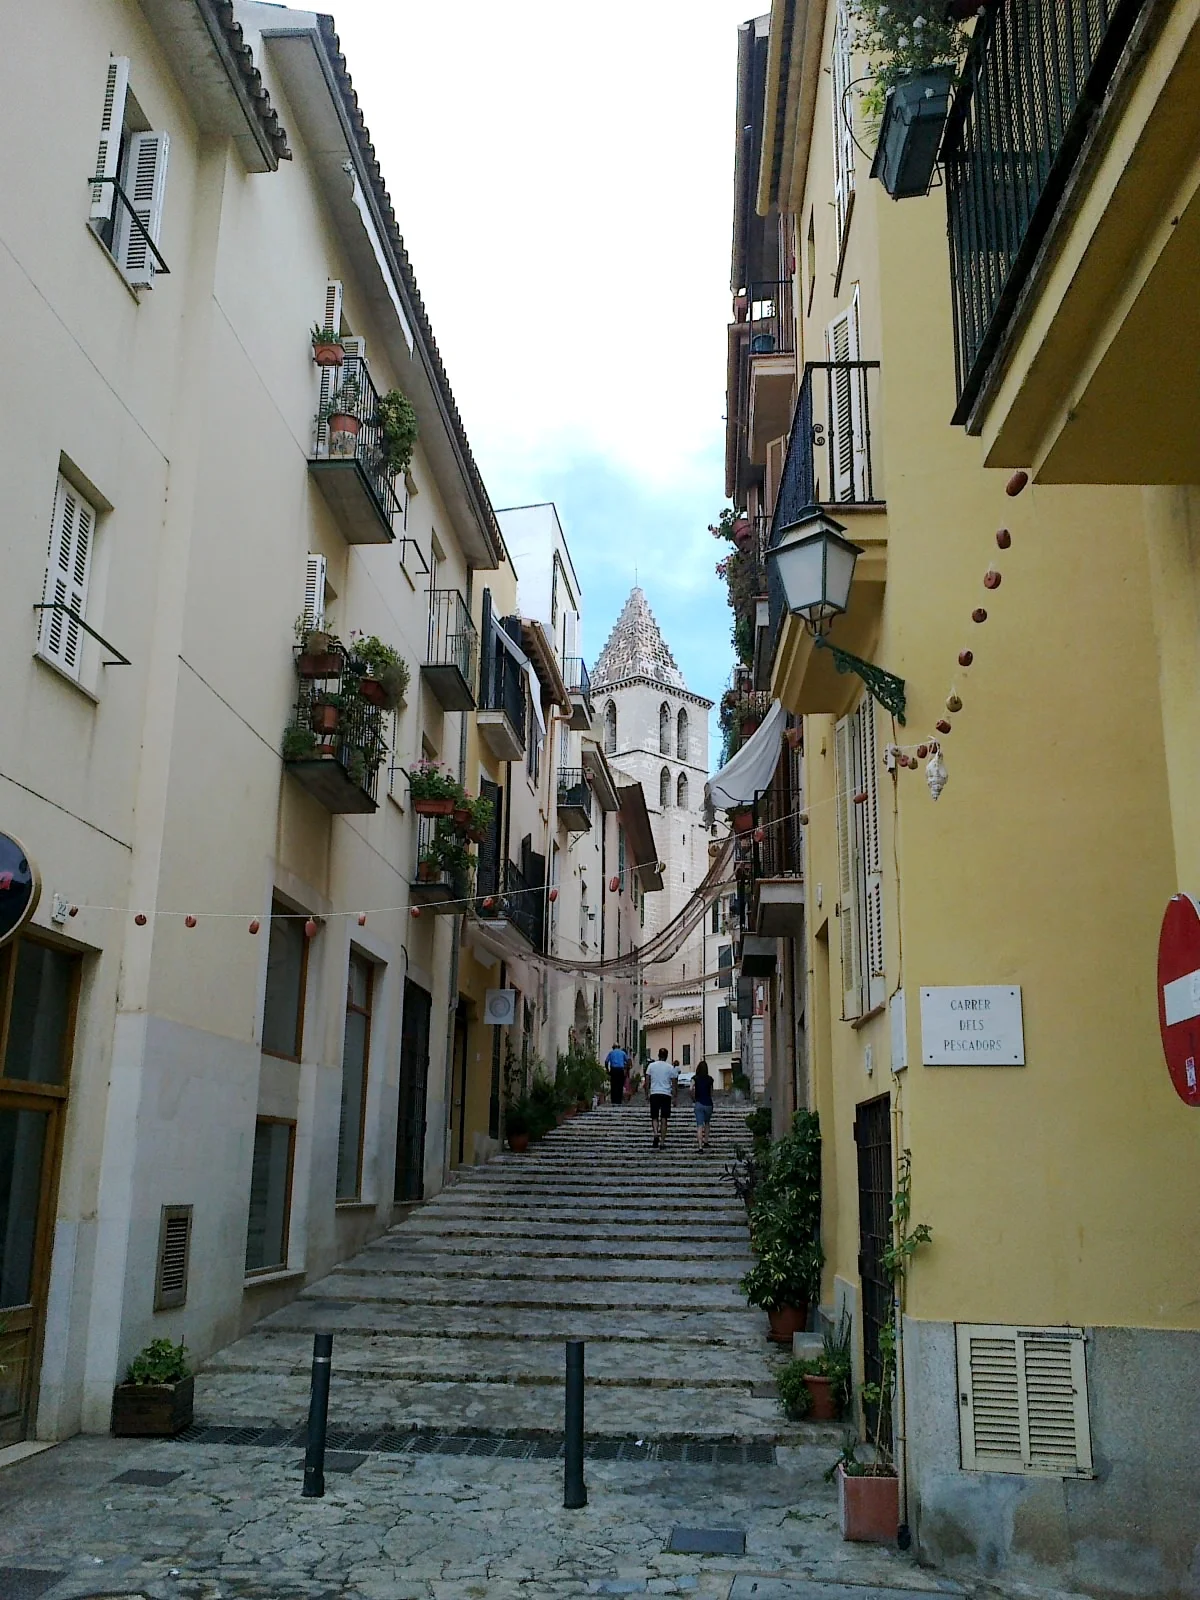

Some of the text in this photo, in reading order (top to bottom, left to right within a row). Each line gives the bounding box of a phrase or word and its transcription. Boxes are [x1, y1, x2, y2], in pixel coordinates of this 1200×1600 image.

[950, 999, 992, 1011] CARRER
[959, 1019, 985, 1031] DELS
[943, 1039, 1002, 1052] PESCADORS
